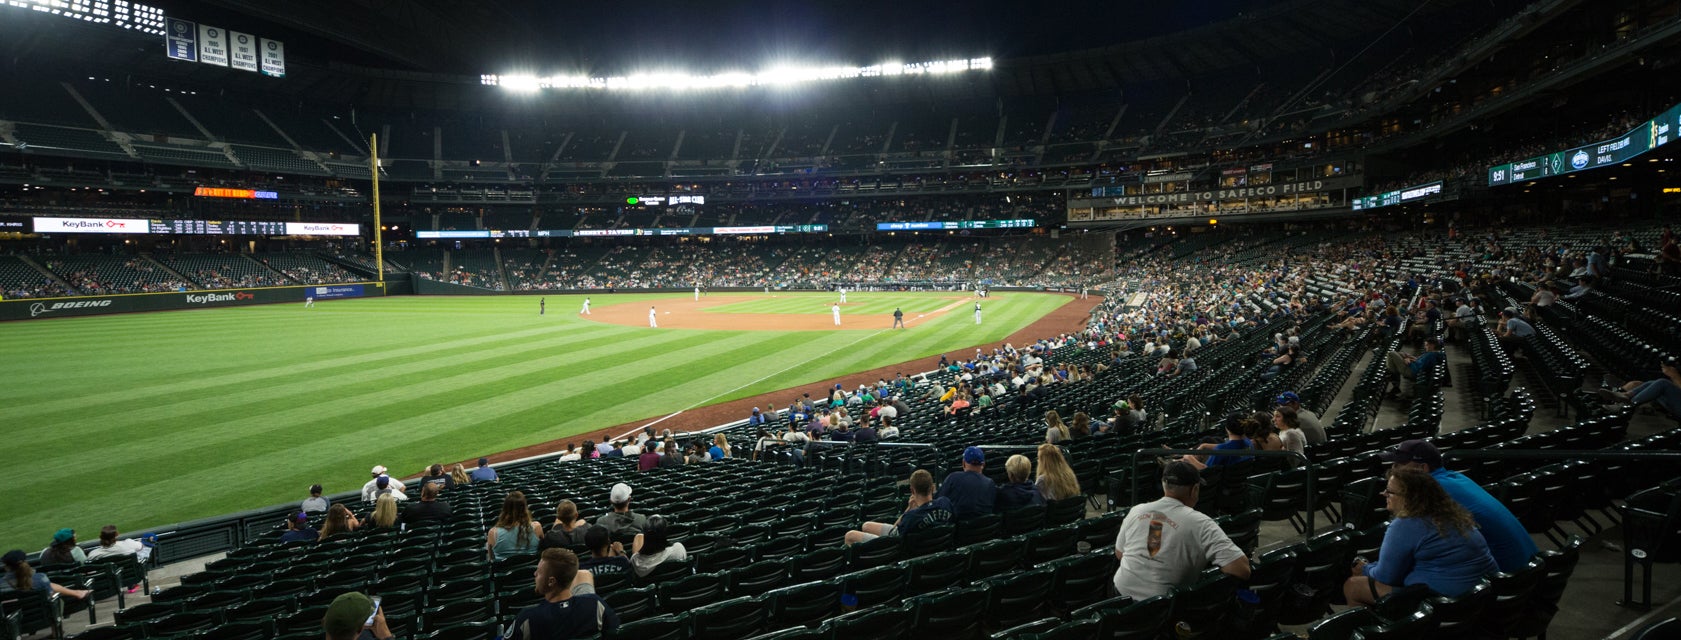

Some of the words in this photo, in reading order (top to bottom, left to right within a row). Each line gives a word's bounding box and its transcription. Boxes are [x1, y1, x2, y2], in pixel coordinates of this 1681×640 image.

[202, 54, 227, 64] CHAMPIONS
[233, 60, 256, 69] CHAMPIONS
[1598, 144, 1610, 154] LEFT
[1494, 169, 1504, 182] 9:51
[1514, 173, 1524, 181] Detroit
[1114, 193, 1187, 205] WELCOME
[1194, 191, 1212, 200] TO
[1219, 186, 1276, 199] SAFECO
[1283, 180, 1322, 193] FIELD
[62, 220, 104, 229] KeyBank
[186, 293, 235, 303] KeyBank
[50, 300, 112, 309] BOEING
